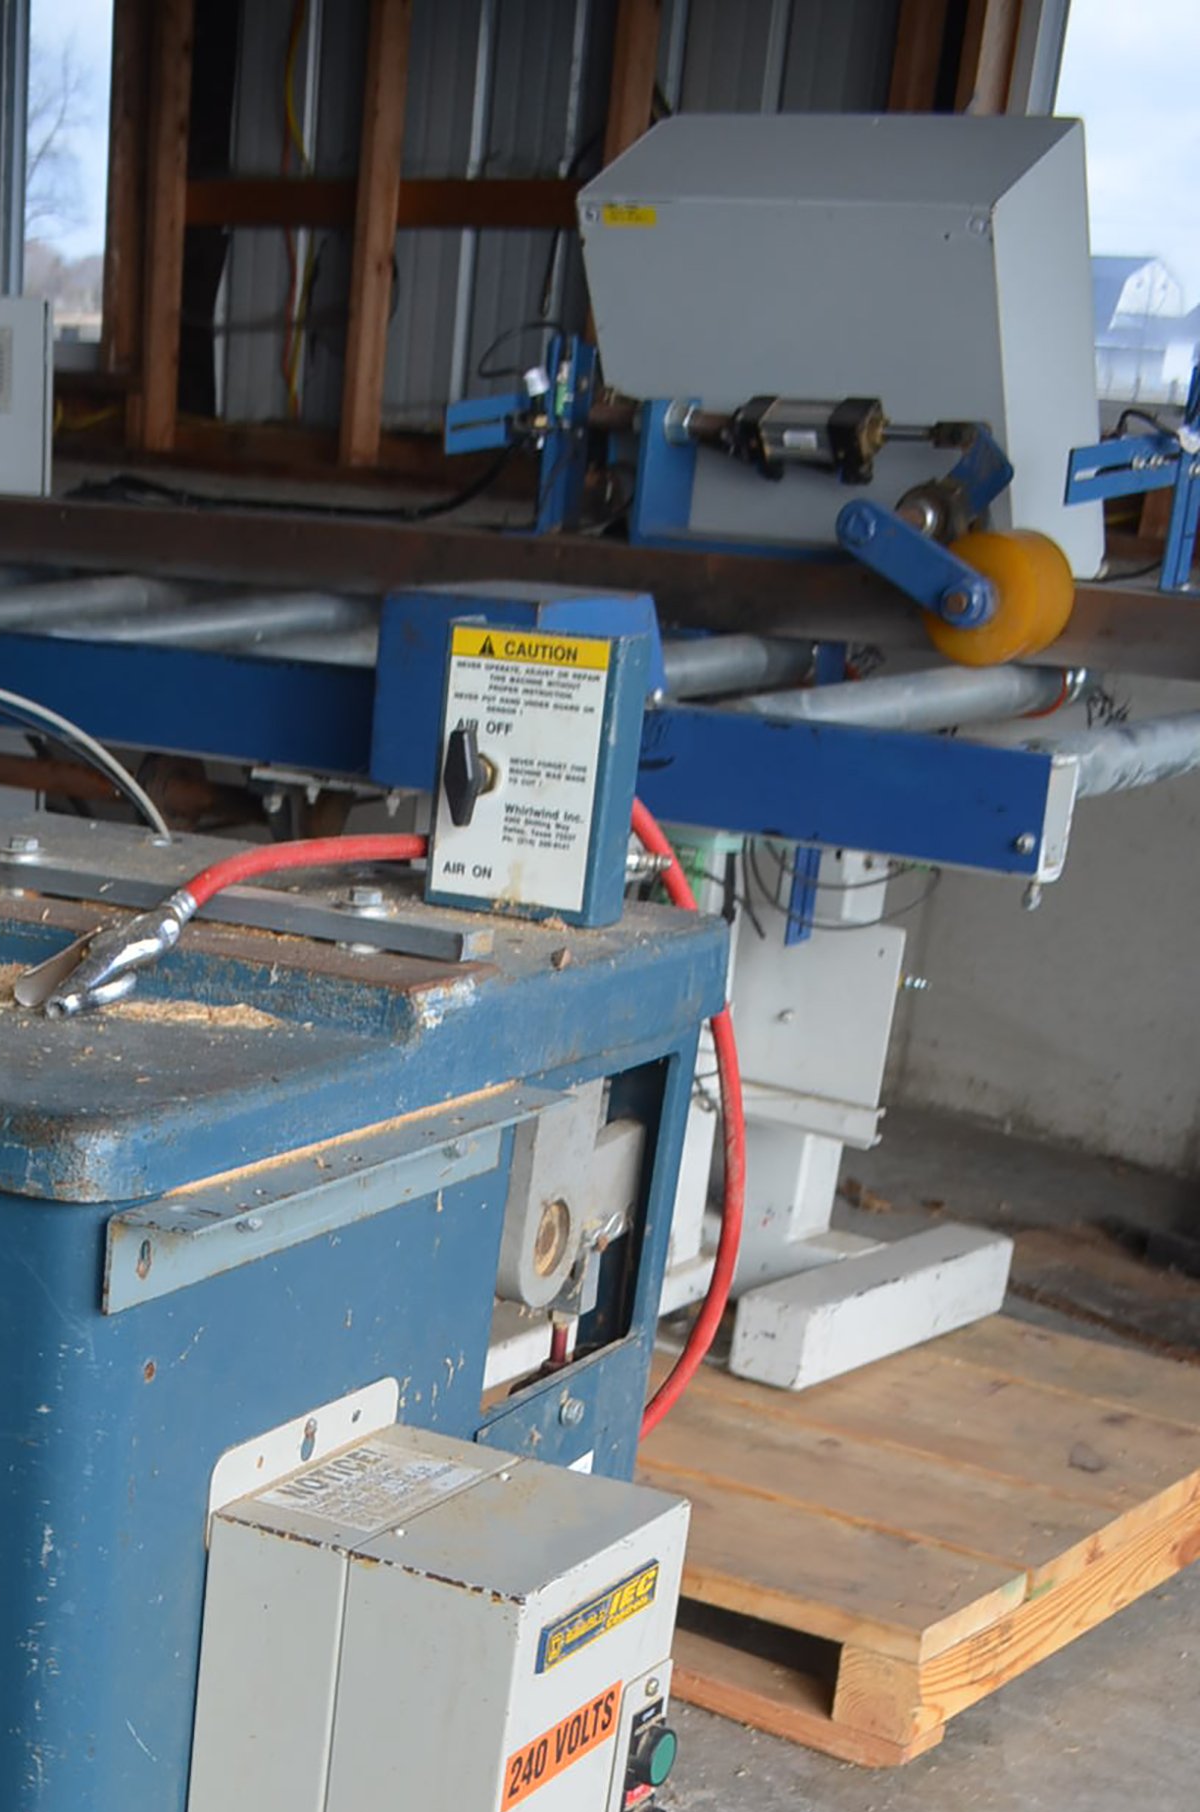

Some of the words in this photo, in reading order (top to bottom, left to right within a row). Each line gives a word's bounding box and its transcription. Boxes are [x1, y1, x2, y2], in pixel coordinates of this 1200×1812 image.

[504, 640, 578, 662] CAUTION
[456, 718, 479, 732] AIR
[485, 720, 513, 736] OFF
[504, 803, 560, 820] Whirlwind
[563, 811, 585, 824] Inc.
[442, 861, 466, 875] AIR
[471, 864, 493, 879] ON
[276, 1447, 389, 1500] NOTICE!
[608, 1568, 658, 1616] IEC
[507, 1738, 549, 1799] 240
[555, 1691, 615, 1765] VOLTS
